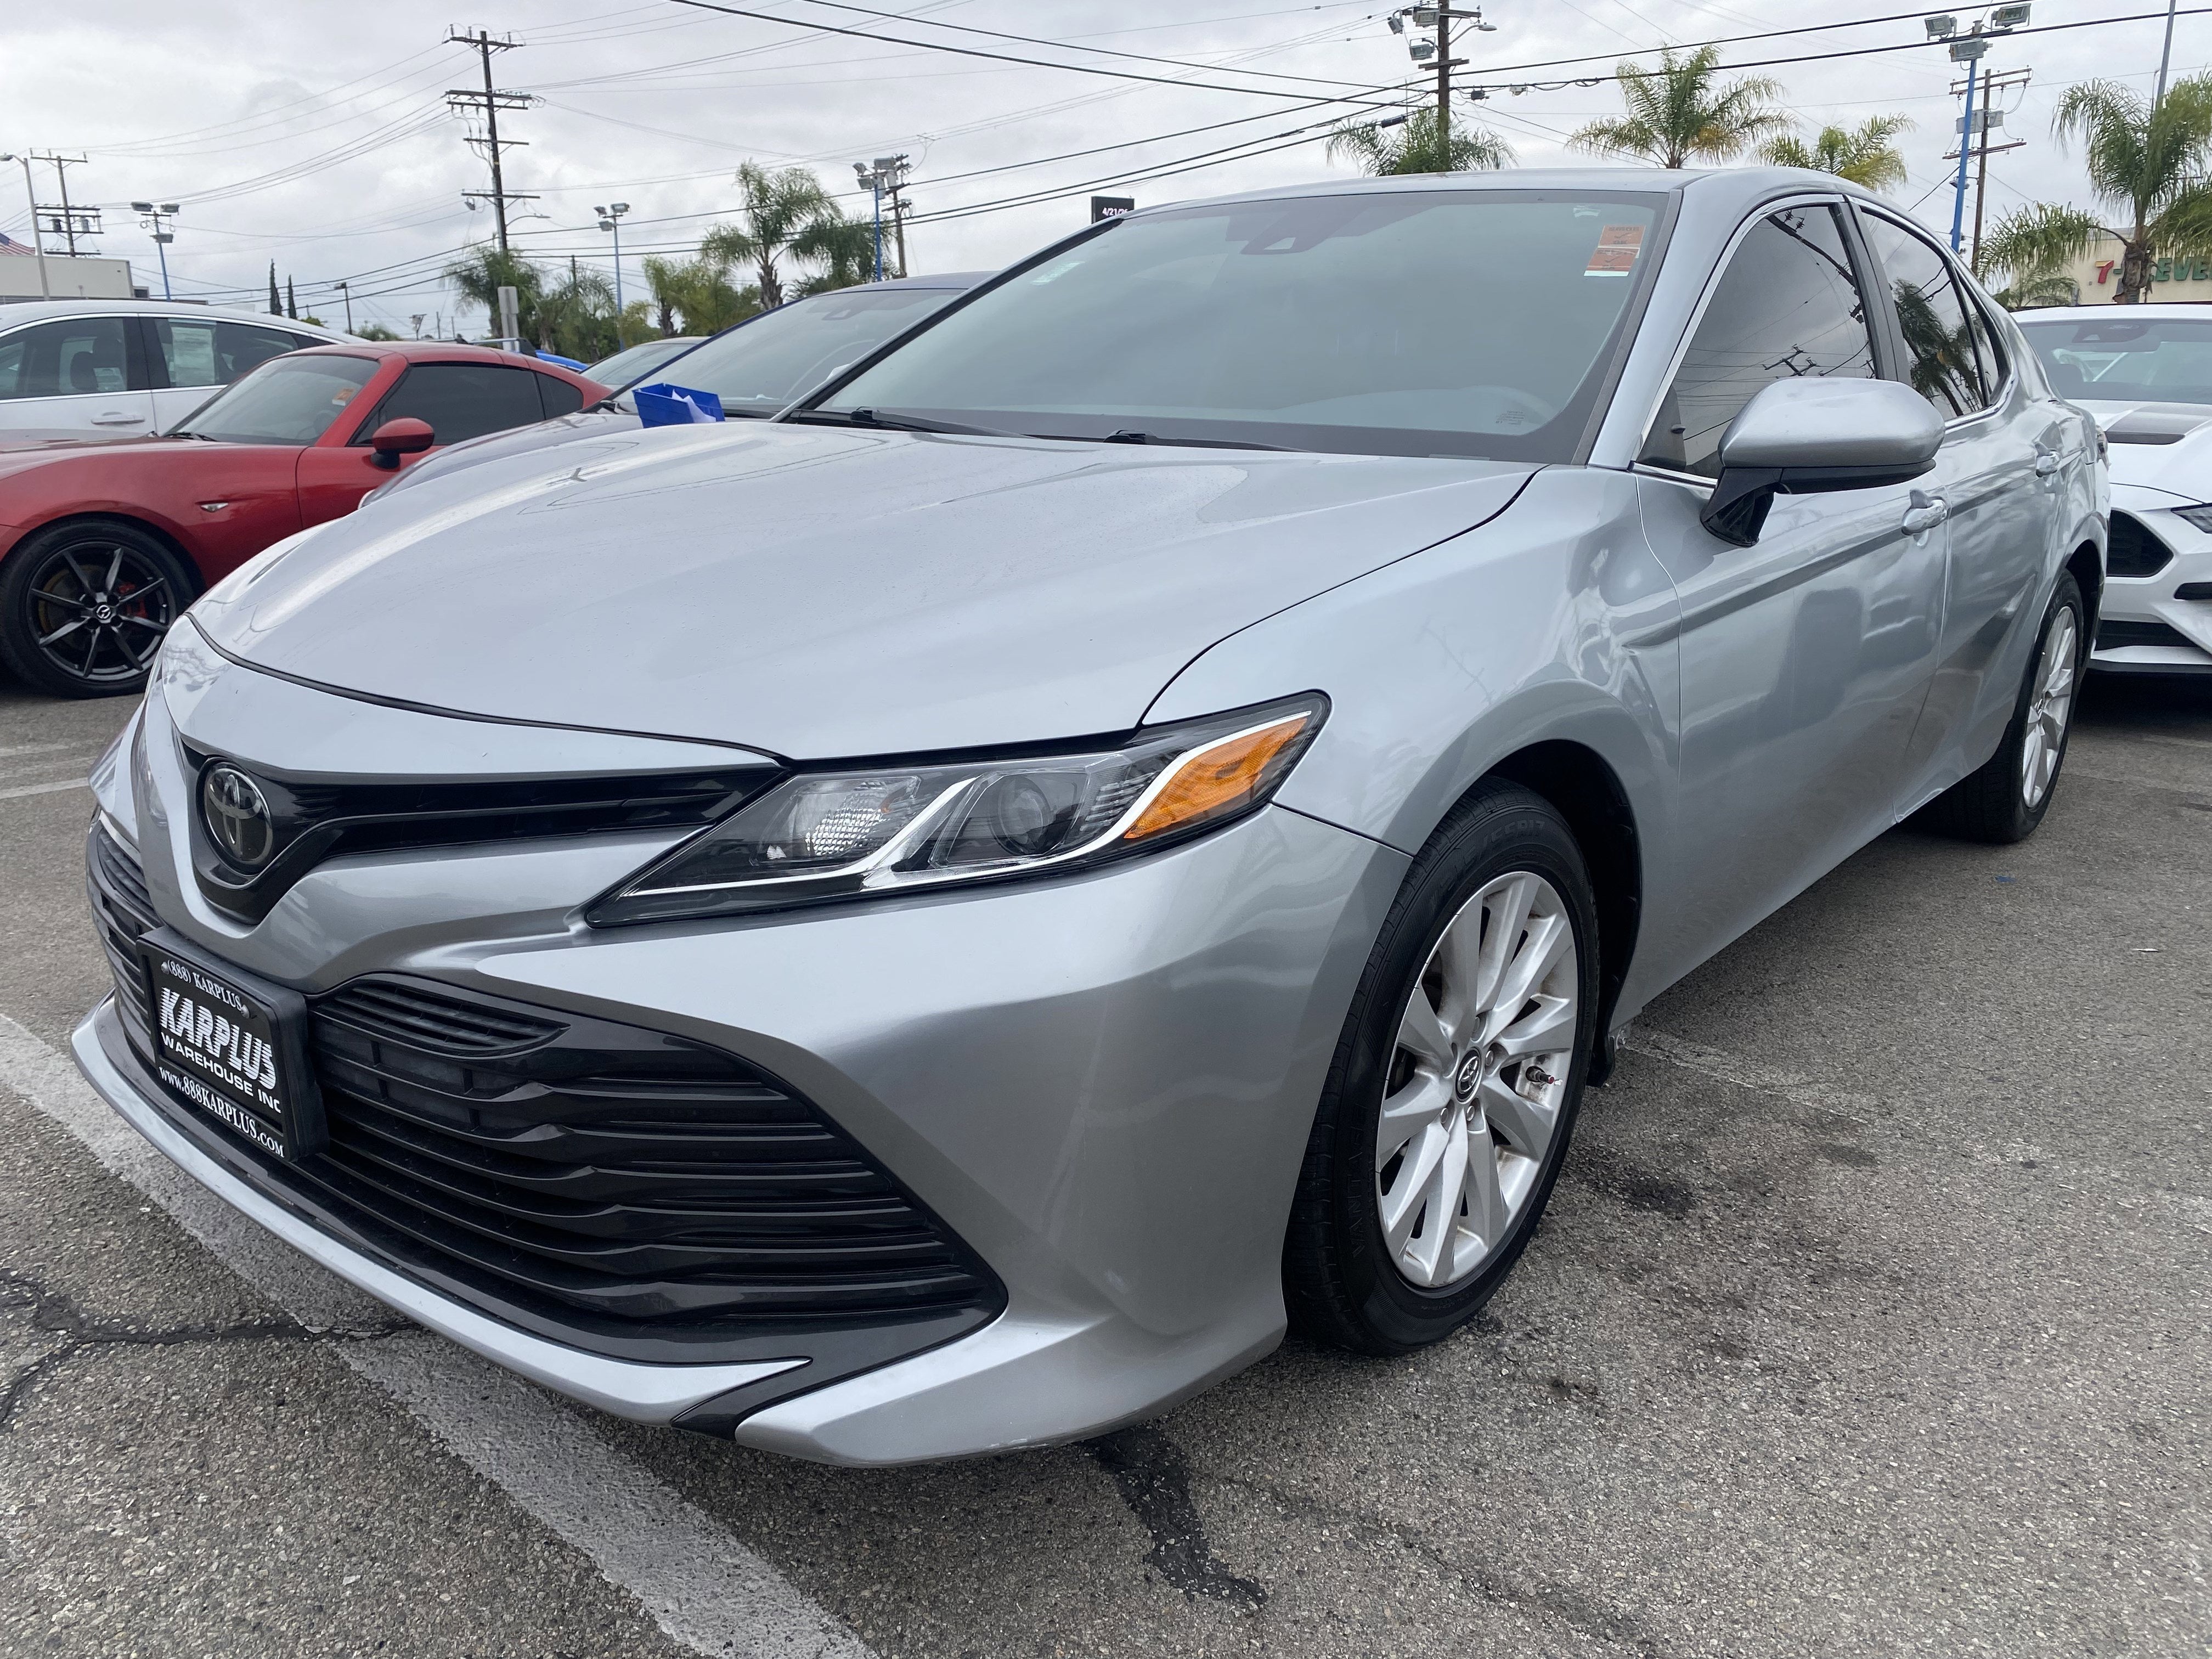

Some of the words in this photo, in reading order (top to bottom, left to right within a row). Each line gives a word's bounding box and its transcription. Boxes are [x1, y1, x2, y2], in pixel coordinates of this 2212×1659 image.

[168, 960, 191, 984] (888)
[193, 972, 242, 1011] KARPLUS
[160, 987, 276, 1090] KARPLUS
[161, 1032, 253, 1097] WAREHOUSE
[258, 1088, 281, 1114] INC
